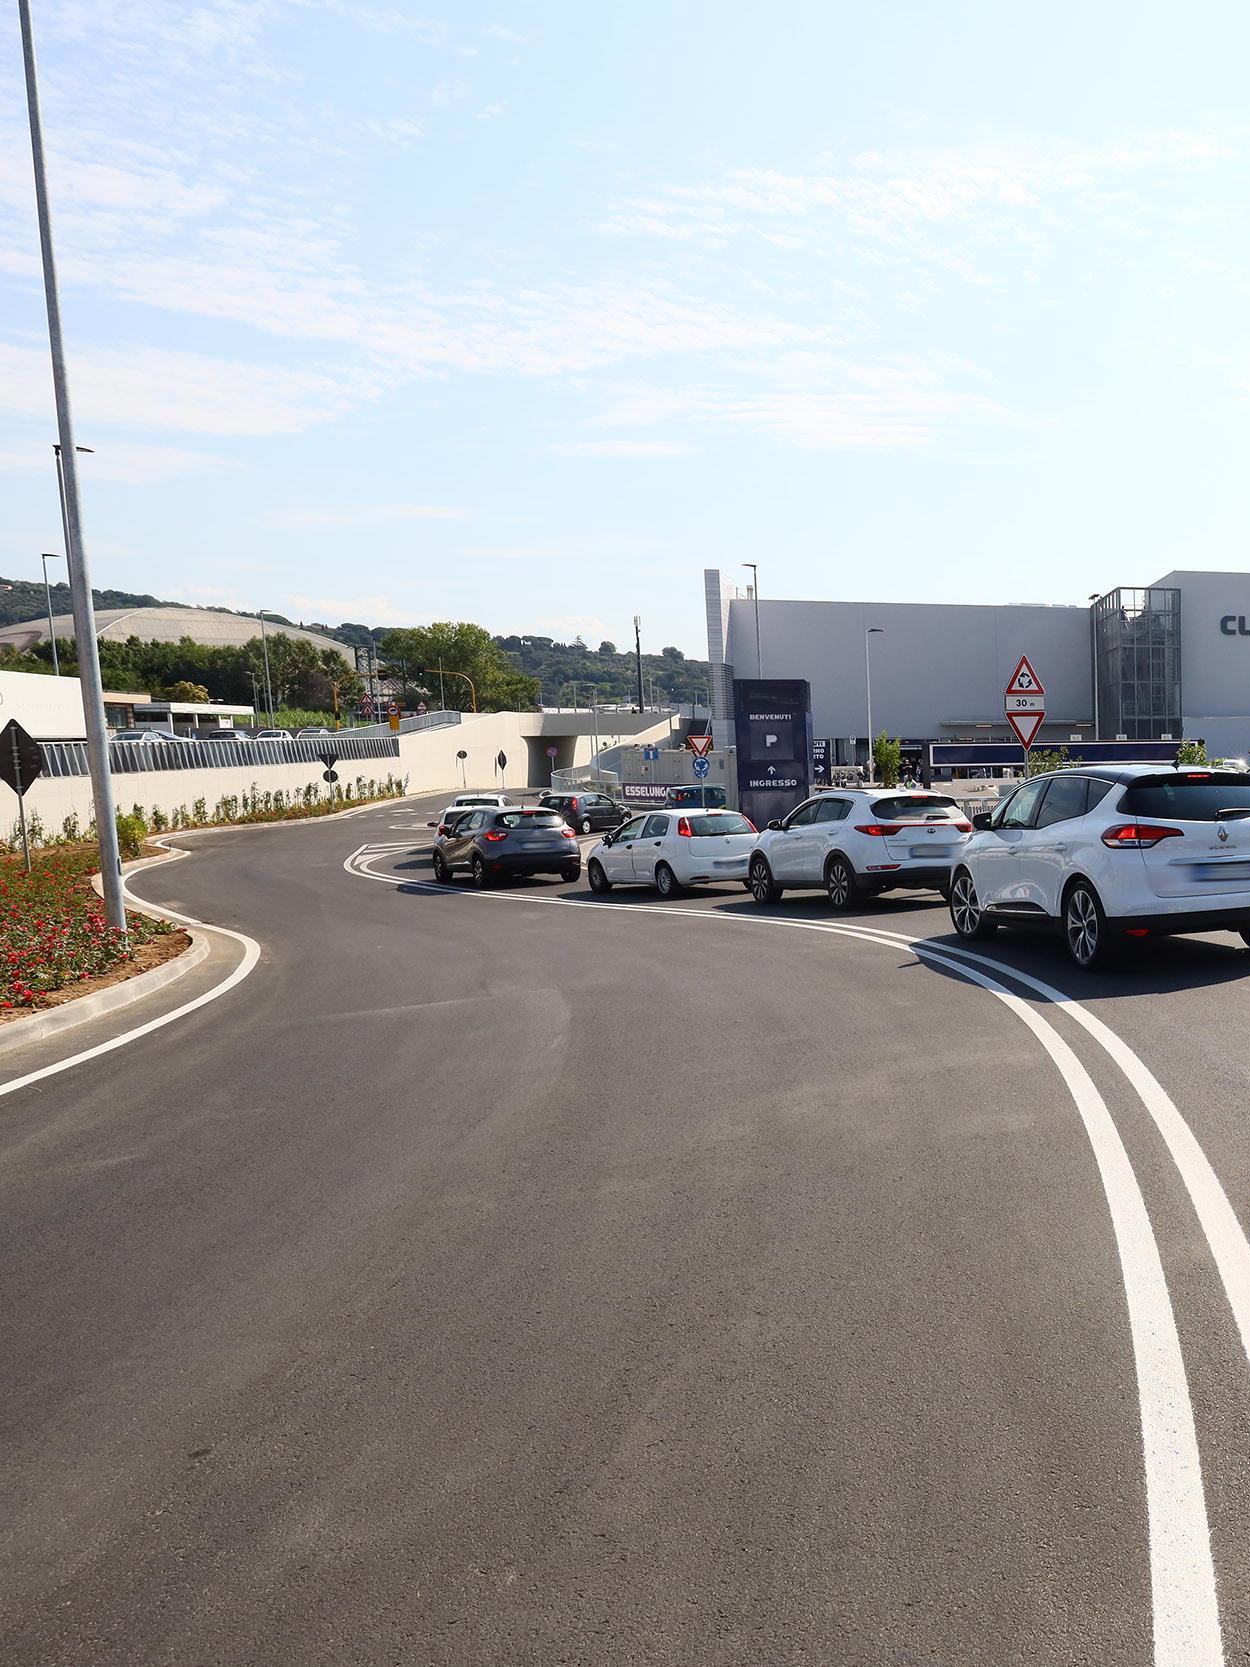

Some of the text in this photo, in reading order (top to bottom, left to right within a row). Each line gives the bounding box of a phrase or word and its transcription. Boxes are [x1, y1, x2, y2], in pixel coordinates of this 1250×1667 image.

[1016, 699, 1027, 707] 30
[766, 734, 777, 747] P
[749, 779, 797, 787] INGRESSO
[625, 785, 670, 797] ESSELUNG
